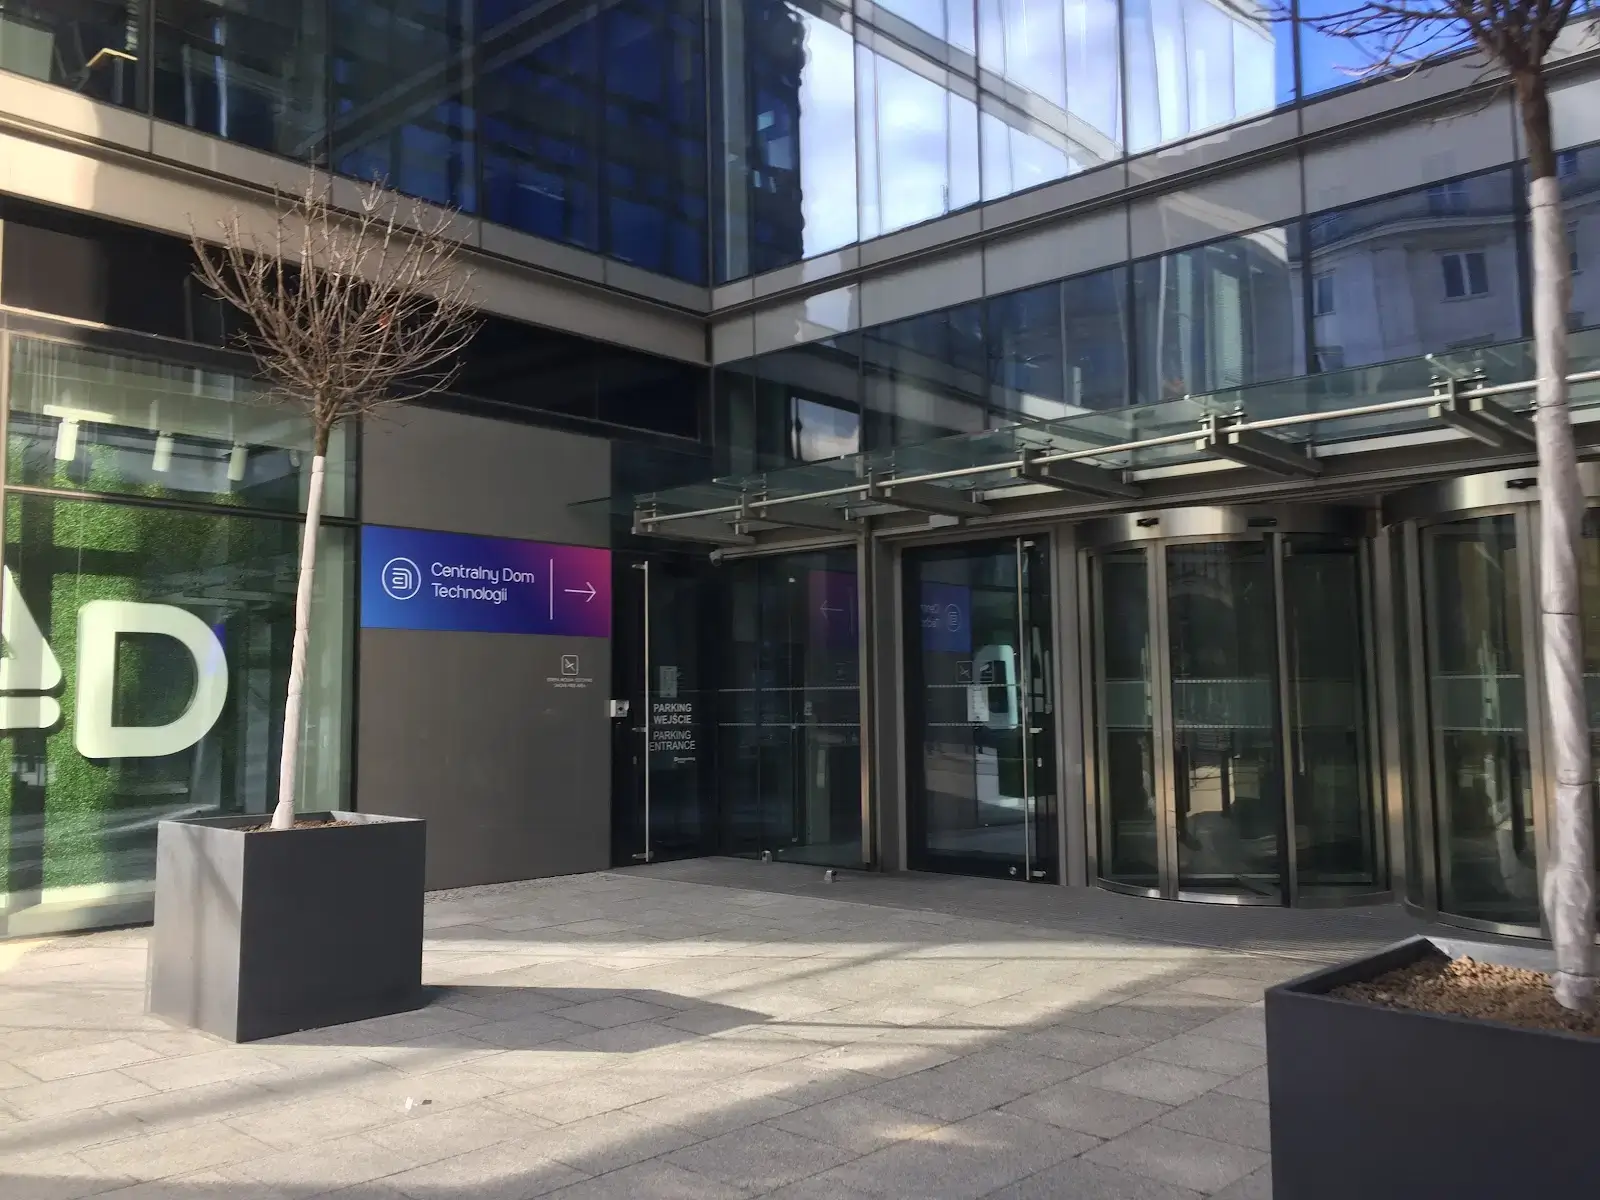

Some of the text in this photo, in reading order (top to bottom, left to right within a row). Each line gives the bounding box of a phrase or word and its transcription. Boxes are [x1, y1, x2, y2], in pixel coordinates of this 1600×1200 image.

[431, 562, 535, 584] Centralny Dom
[431, 582, 508, 605] Technologii
[653, 702, 692, 713] PARKING
[653, 713, 692, 725] WEJŚCIE
[653, 730, 692, 741] PARKING
[649, 740, 696, 751] ENTRANCE
